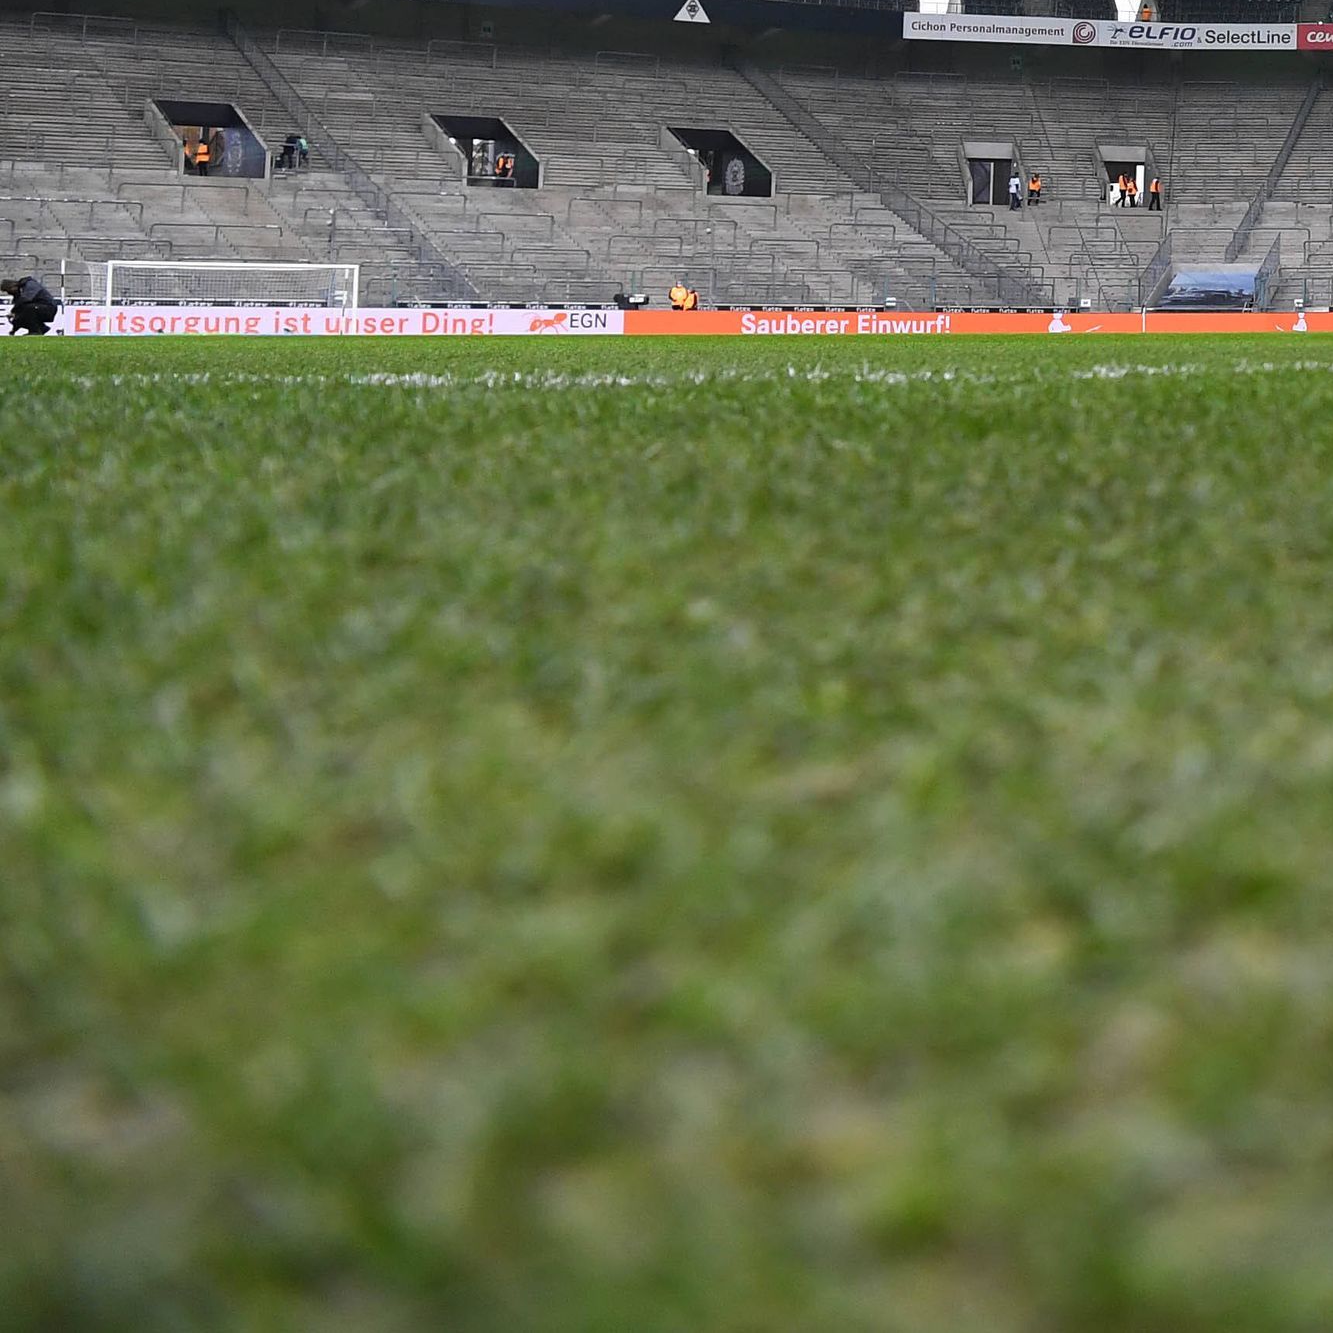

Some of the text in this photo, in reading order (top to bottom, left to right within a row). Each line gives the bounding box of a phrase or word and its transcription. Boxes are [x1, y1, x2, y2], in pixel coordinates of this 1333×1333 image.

[911, 21, 1065, 37] Cichon Personalmanagement
[1205, 29, 1291, 44] SelectLine
[75, 309, 494, 335] Entsorgung ist unser Ding!
[570, 313, 608, 328] EGN
[741, 314, 951, 334] Sauberer Einwurf!
